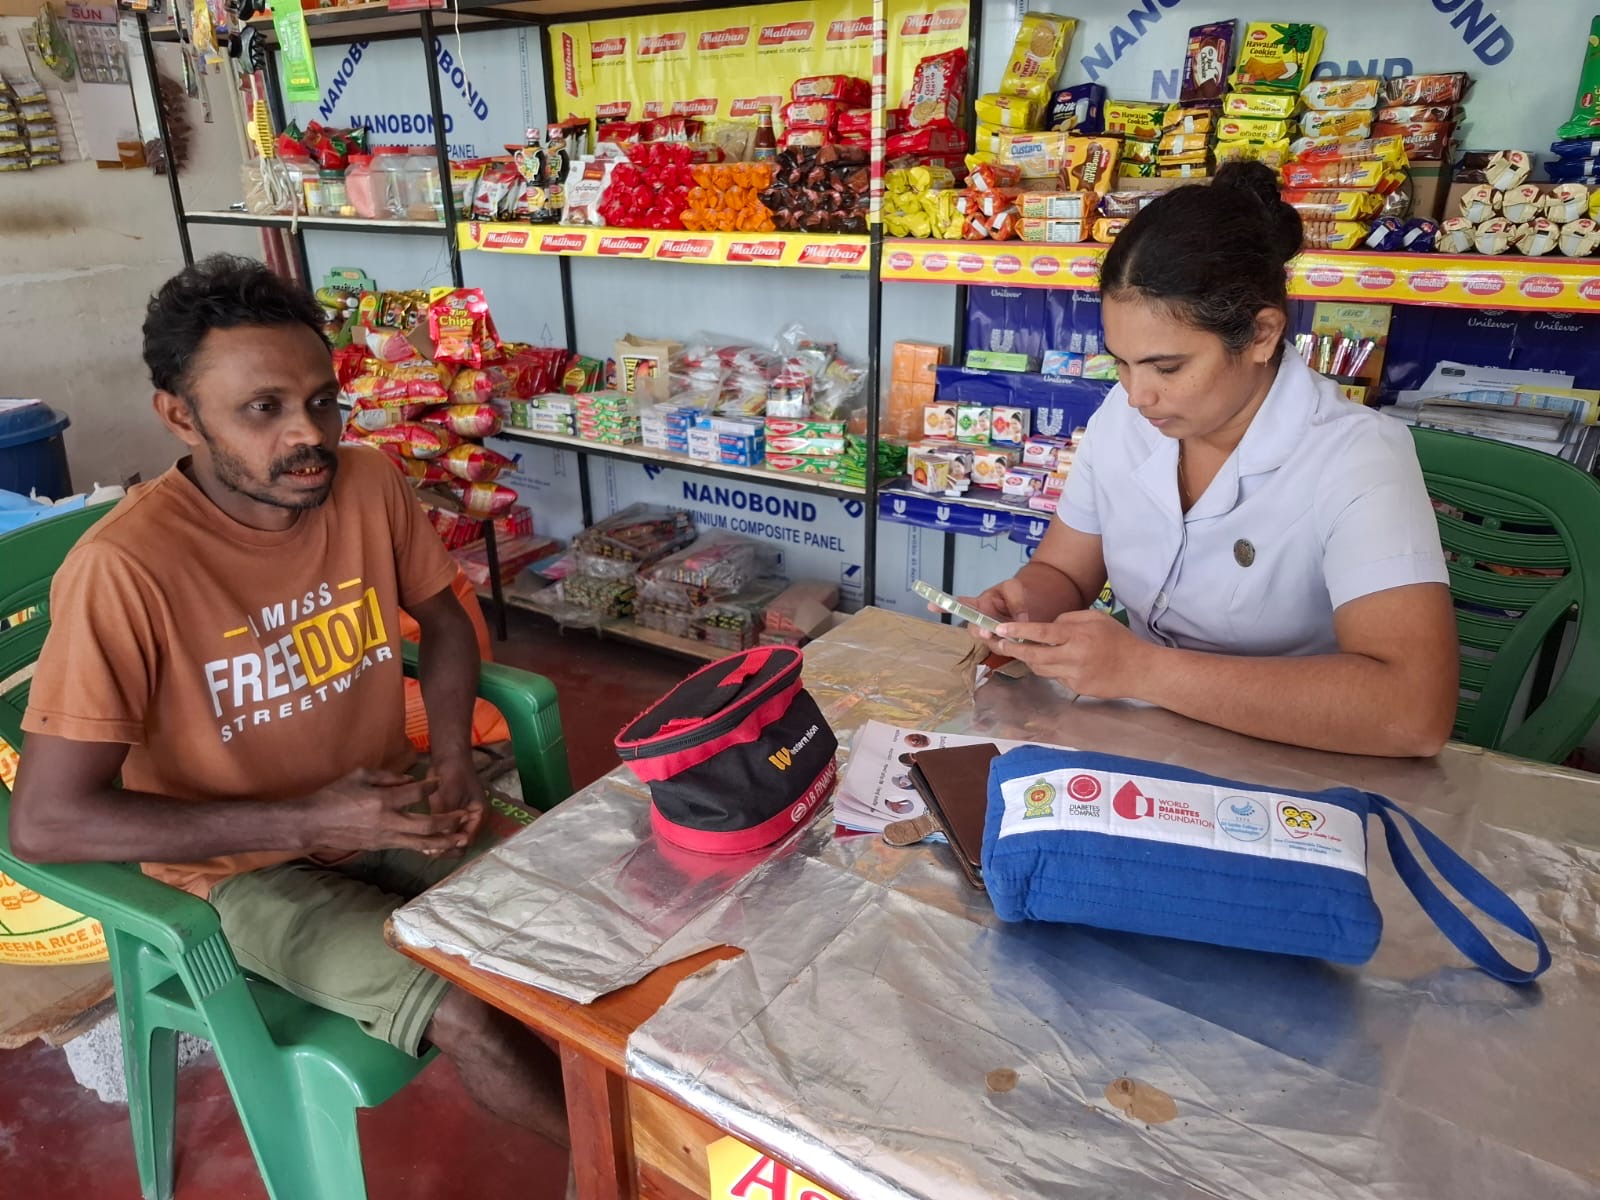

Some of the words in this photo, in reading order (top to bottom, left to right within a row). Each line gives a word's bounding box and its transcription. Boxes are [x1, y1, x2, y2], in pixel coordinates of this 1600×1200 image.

[71, 8, 103, 21] SUN
[831, 20, 873, 34] Maliba
[906, 14, 961, 29] Maliban
[701, 30, 745, 43] Maliban
[762, 26, 808, 39] Maliban
[640, 37, 682, 51] Maliban
[1250, 48, 1277, 56] Cookies
[673, 101, 715, 113] Maliban
[1052, 101, 1076, 113] Milk
[1127, 118, 1150, 126] Cookies
[447, 143, 479, 159] PANEL
[1087, 149, 1102, 185] CHOCOLATE
[487, 231, 525, 246] Maliban
[543, 235, 583, 248] Maliban
[601, 237, 643, 250] Maliban
[661, 240, 708, 254] Maliban
[732, 242, 782, 257] Maliban
[805, 246, 859, 260] Maliban
[1466, 280, 1501, 291] Munchee
[1523, 282, 1560, 294] Munchee
[991, 288, 1022, 299] Unilever
[439, 315, 475, 328] Chips
[1467, 317, 1515, 330] Unilever
[1534, 320, 1584, 332] Unilever
[1043, 374, 1075, 385] Unilever
[682, 481, 817, 523] NANOBOND
[730, 517, 801, 544] COMPOSITE
[804, 531, 846, 553] PANEL
[247, 613, 261, 639] I
[261, 582, 333, 632] MISS
[220, 645, 394, 743] STREETWEAR
[814, 761, 836, 797] FINANCE
[1069, 803, 1101, 812] DIABETES
[1158, 798, 1190, 810] WORLD
[1069, 809, 1101, 818] COMPASS
[1158, 805, 1200, 818] DIABETES
[1158, 813, 1215, 829] FOUNDATION
[48, 928, 89, 949] RICE
